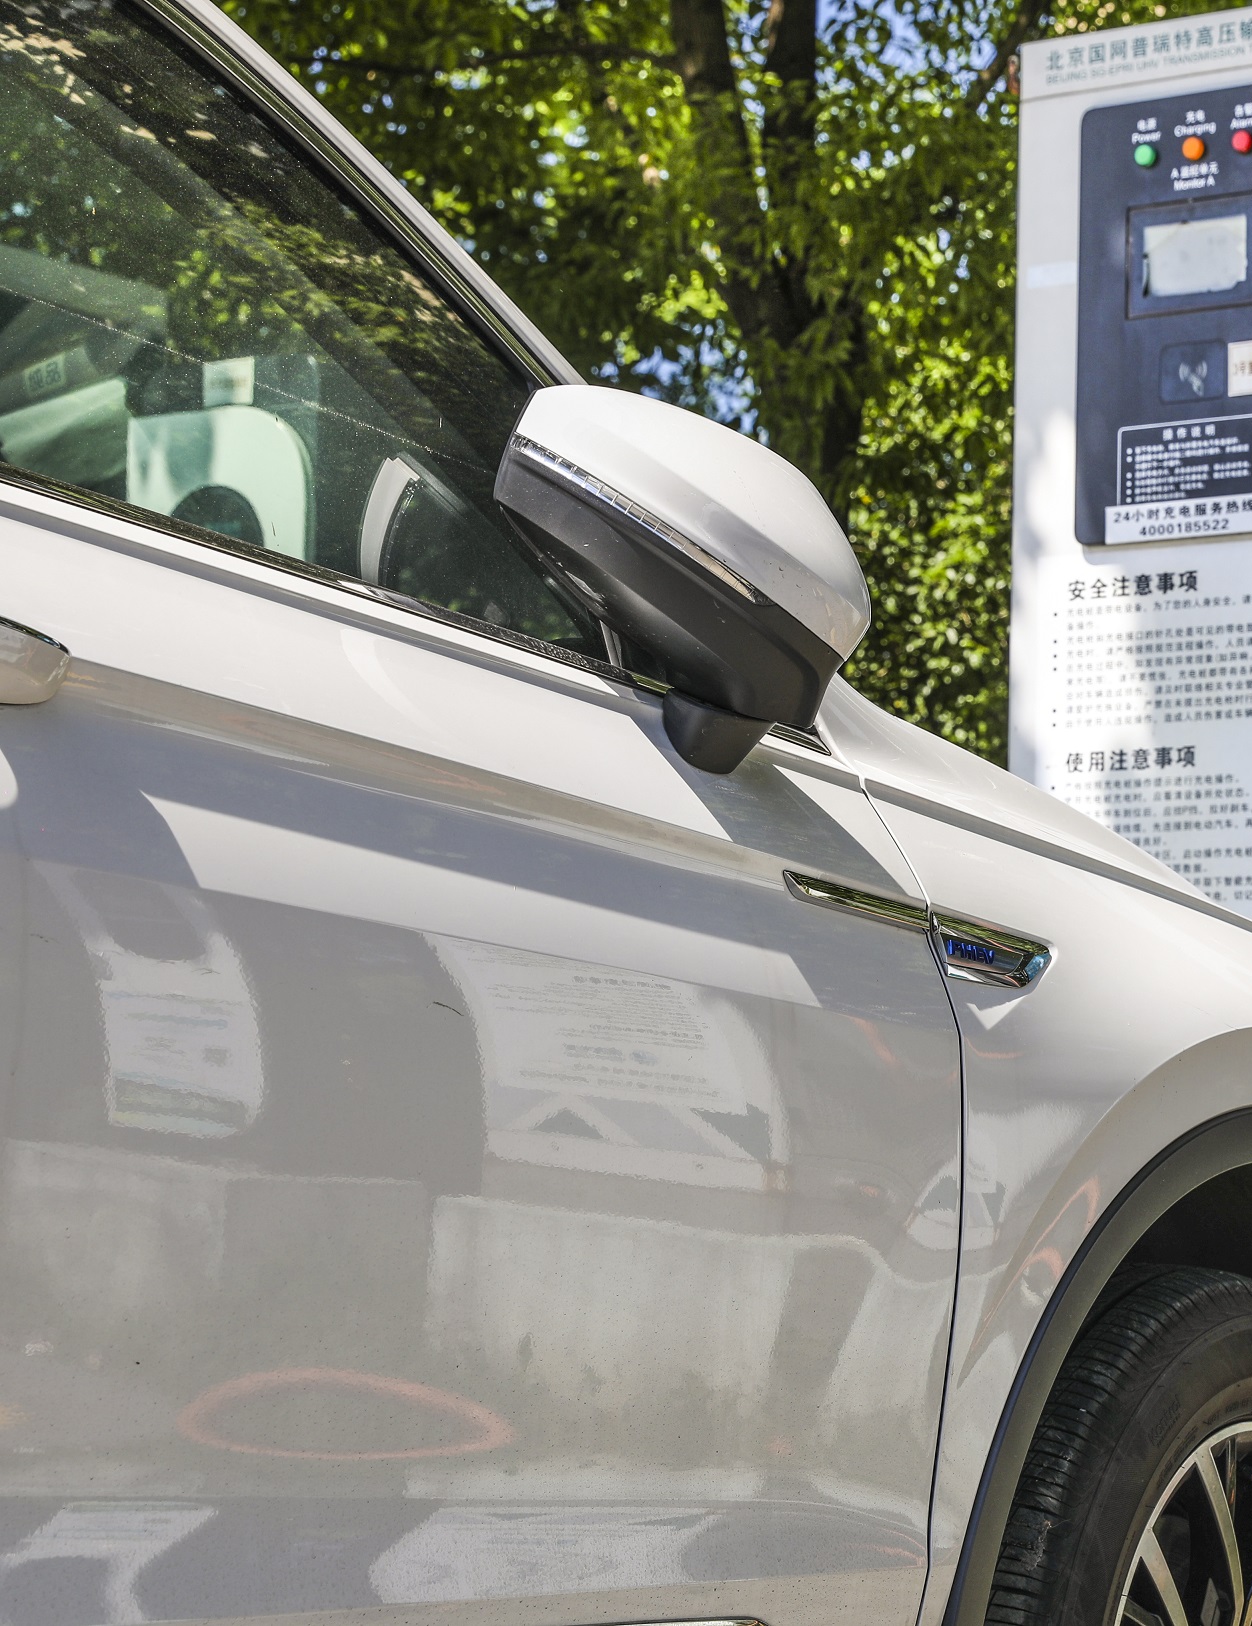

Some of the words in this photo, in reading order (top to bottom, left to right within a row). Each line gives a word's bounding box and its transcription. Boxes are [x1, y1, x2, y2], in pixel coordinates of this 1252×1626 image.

[1163, 45, 1245, 66] TRANSMISSION
[1131, 130, 1162, 144] Power
[1174, 122, 1217, 137] Charging
[1173, 178, 1206, 191] Monitor
[1206, 175, 1216, 187] A
[1140, 519, 1230, 536] 4000185522
[1068, 570, 1198, 601] 安全注意事项
[1066, 745, 1196, 773] 使用注意事项
